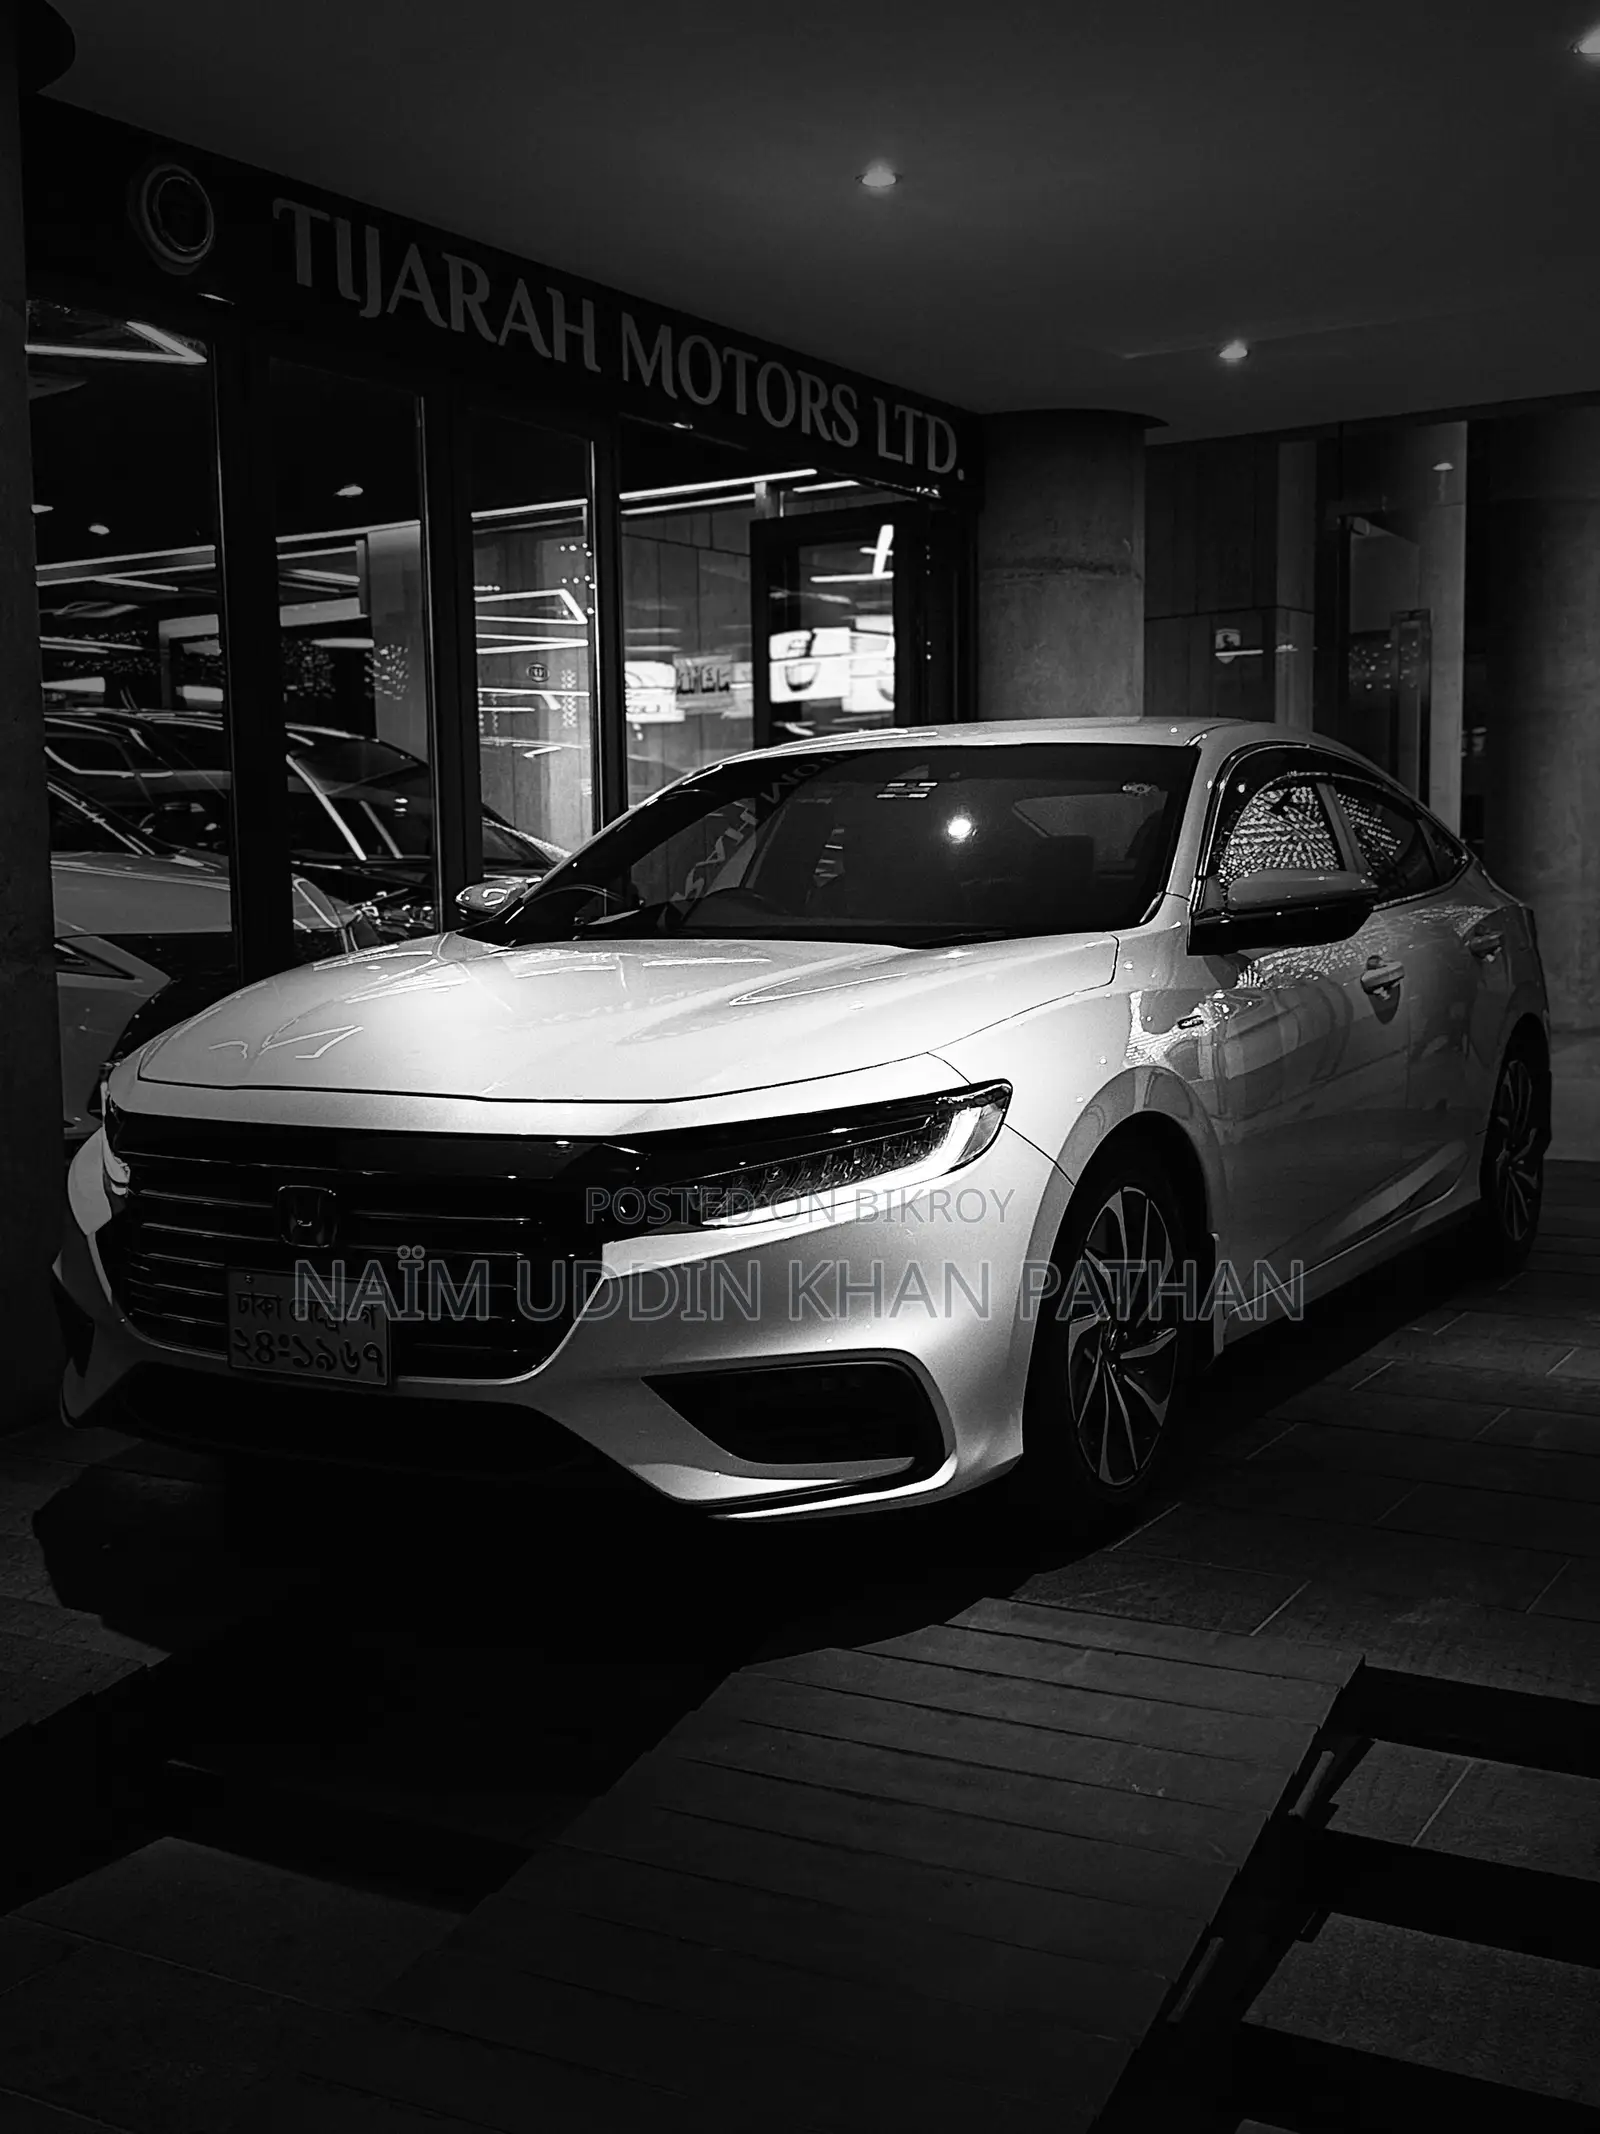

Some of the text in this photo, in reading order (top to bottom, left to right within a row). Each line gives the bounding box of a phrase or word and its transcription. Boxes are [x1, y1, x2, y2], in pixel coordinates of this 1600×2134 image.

[272, 197, 965, 482] TIJARAH MOTORS LTD.
[235, 1292, 282, 1320] ঢাকা
